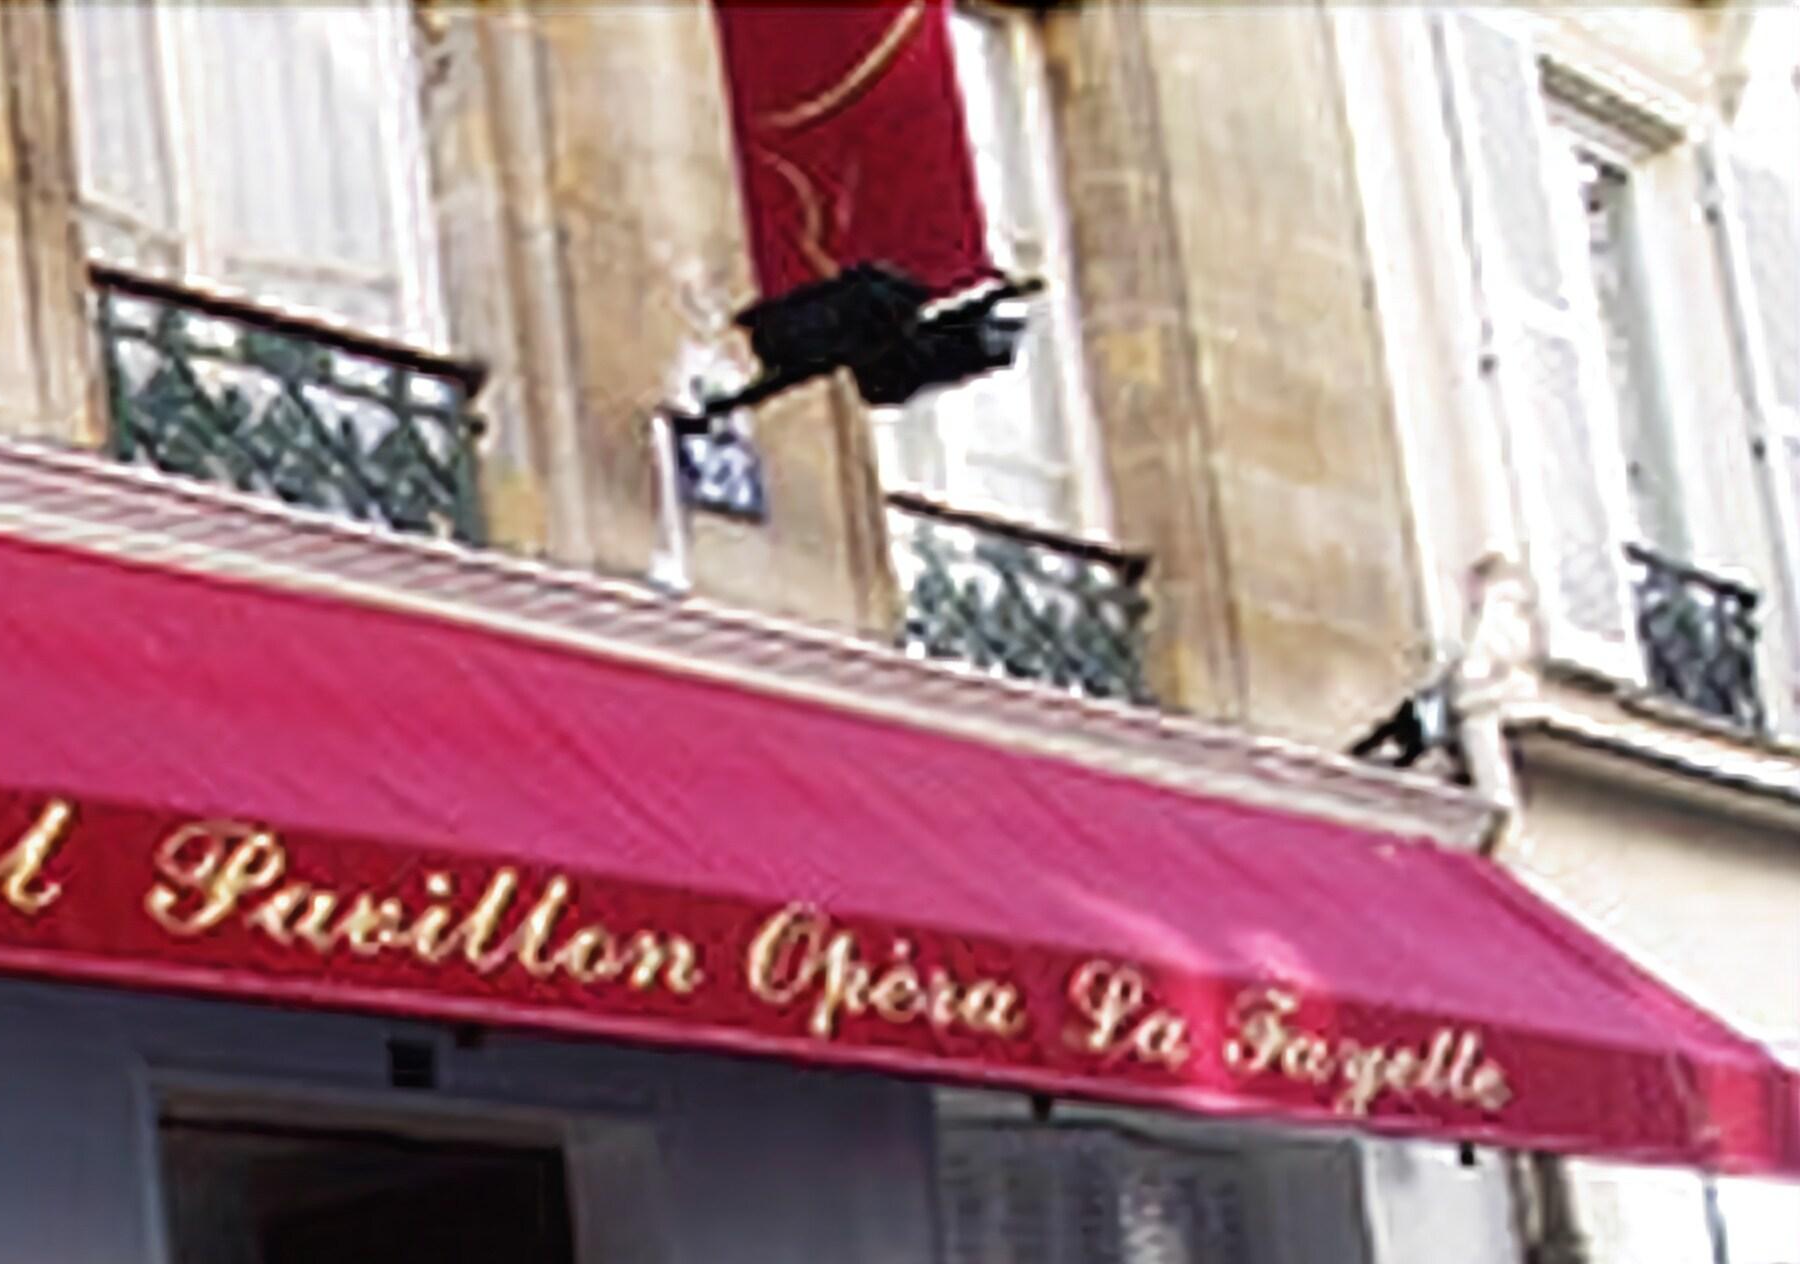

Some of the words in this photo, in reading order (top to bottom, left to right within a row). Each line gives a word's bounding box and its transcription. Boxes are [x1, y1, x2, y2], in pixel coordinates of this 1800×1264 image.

[144, 818, 704, 992] Pavillon
[1064, 958, 1190, 1066] La
[1223, 986, 1512, 1117] Fayette
